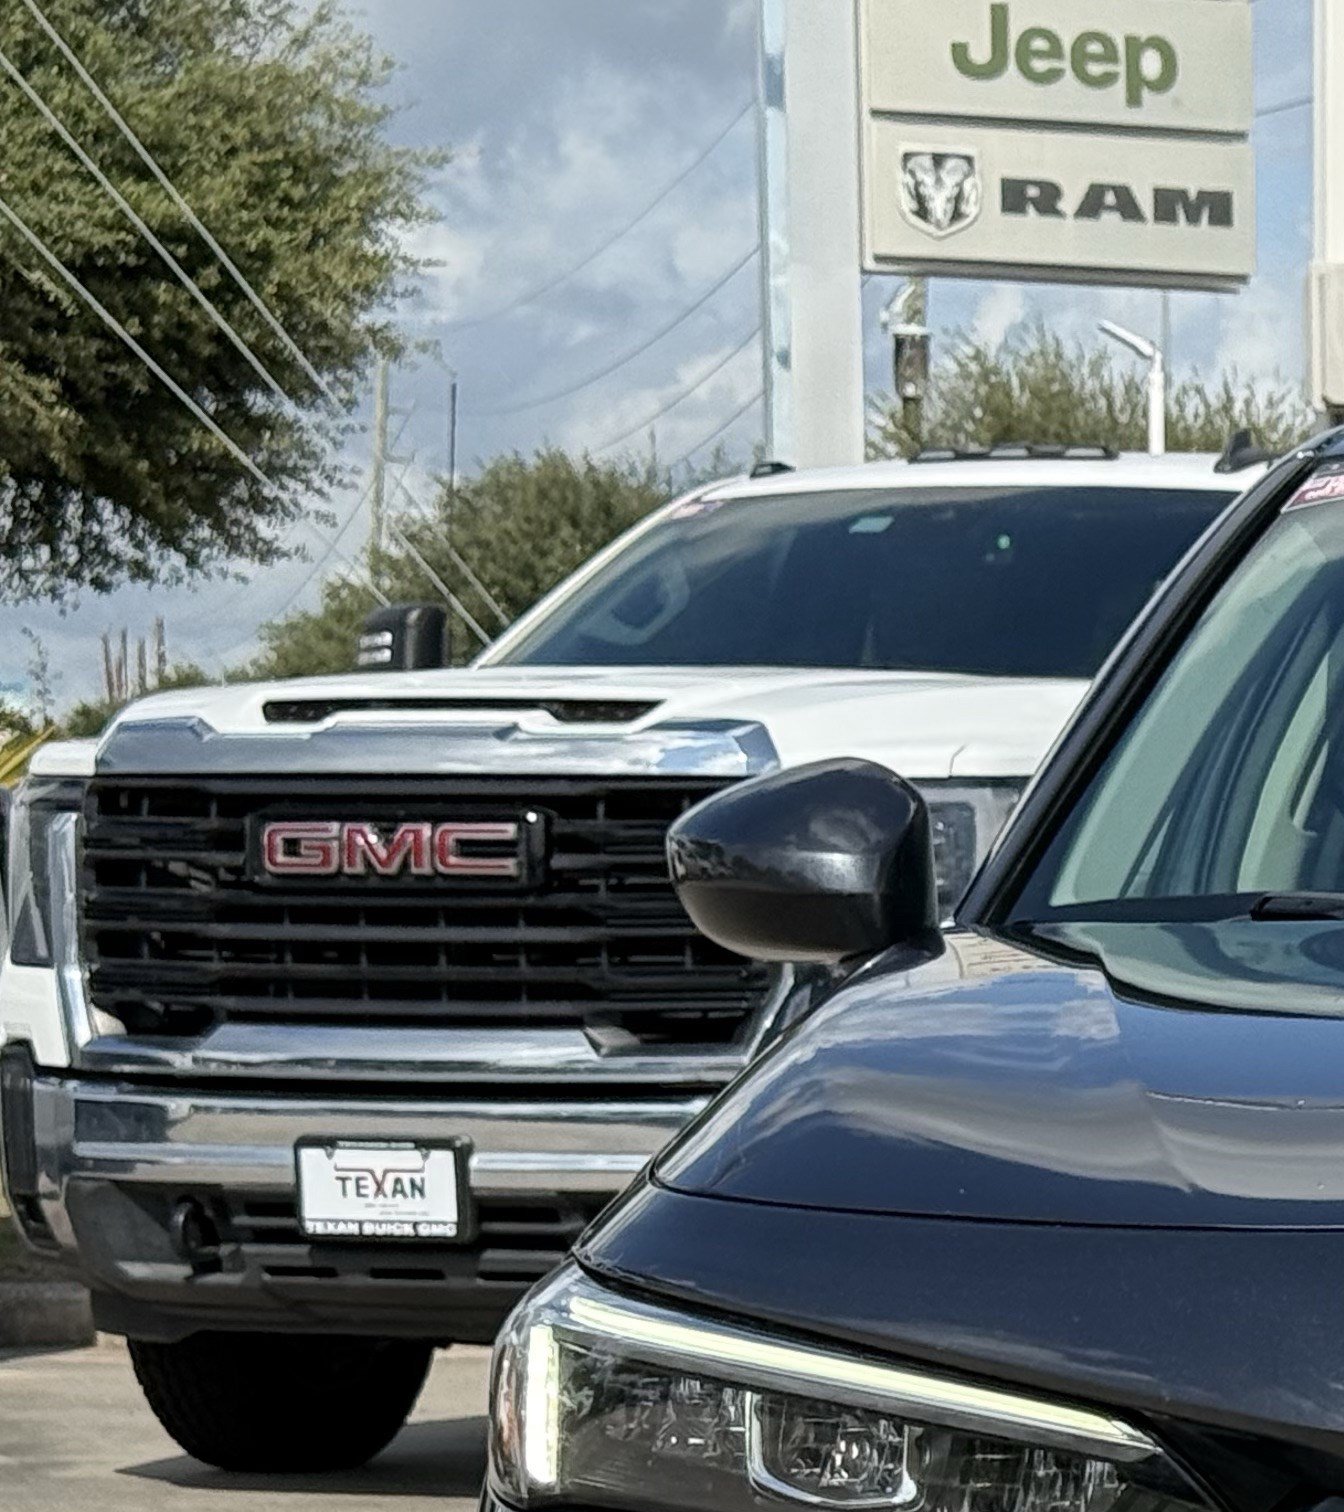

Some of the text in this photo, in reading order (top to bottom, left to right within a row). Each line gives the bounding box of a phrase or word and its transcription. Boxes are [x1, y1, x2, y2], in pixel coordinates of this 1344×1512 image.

[951, 3, 1178, 108] Jeep
[1000, 176, 1235, 228] RAM
[264, 821, 518, 876] GMC
[334, 1168, 426, 1200] TEXAN
